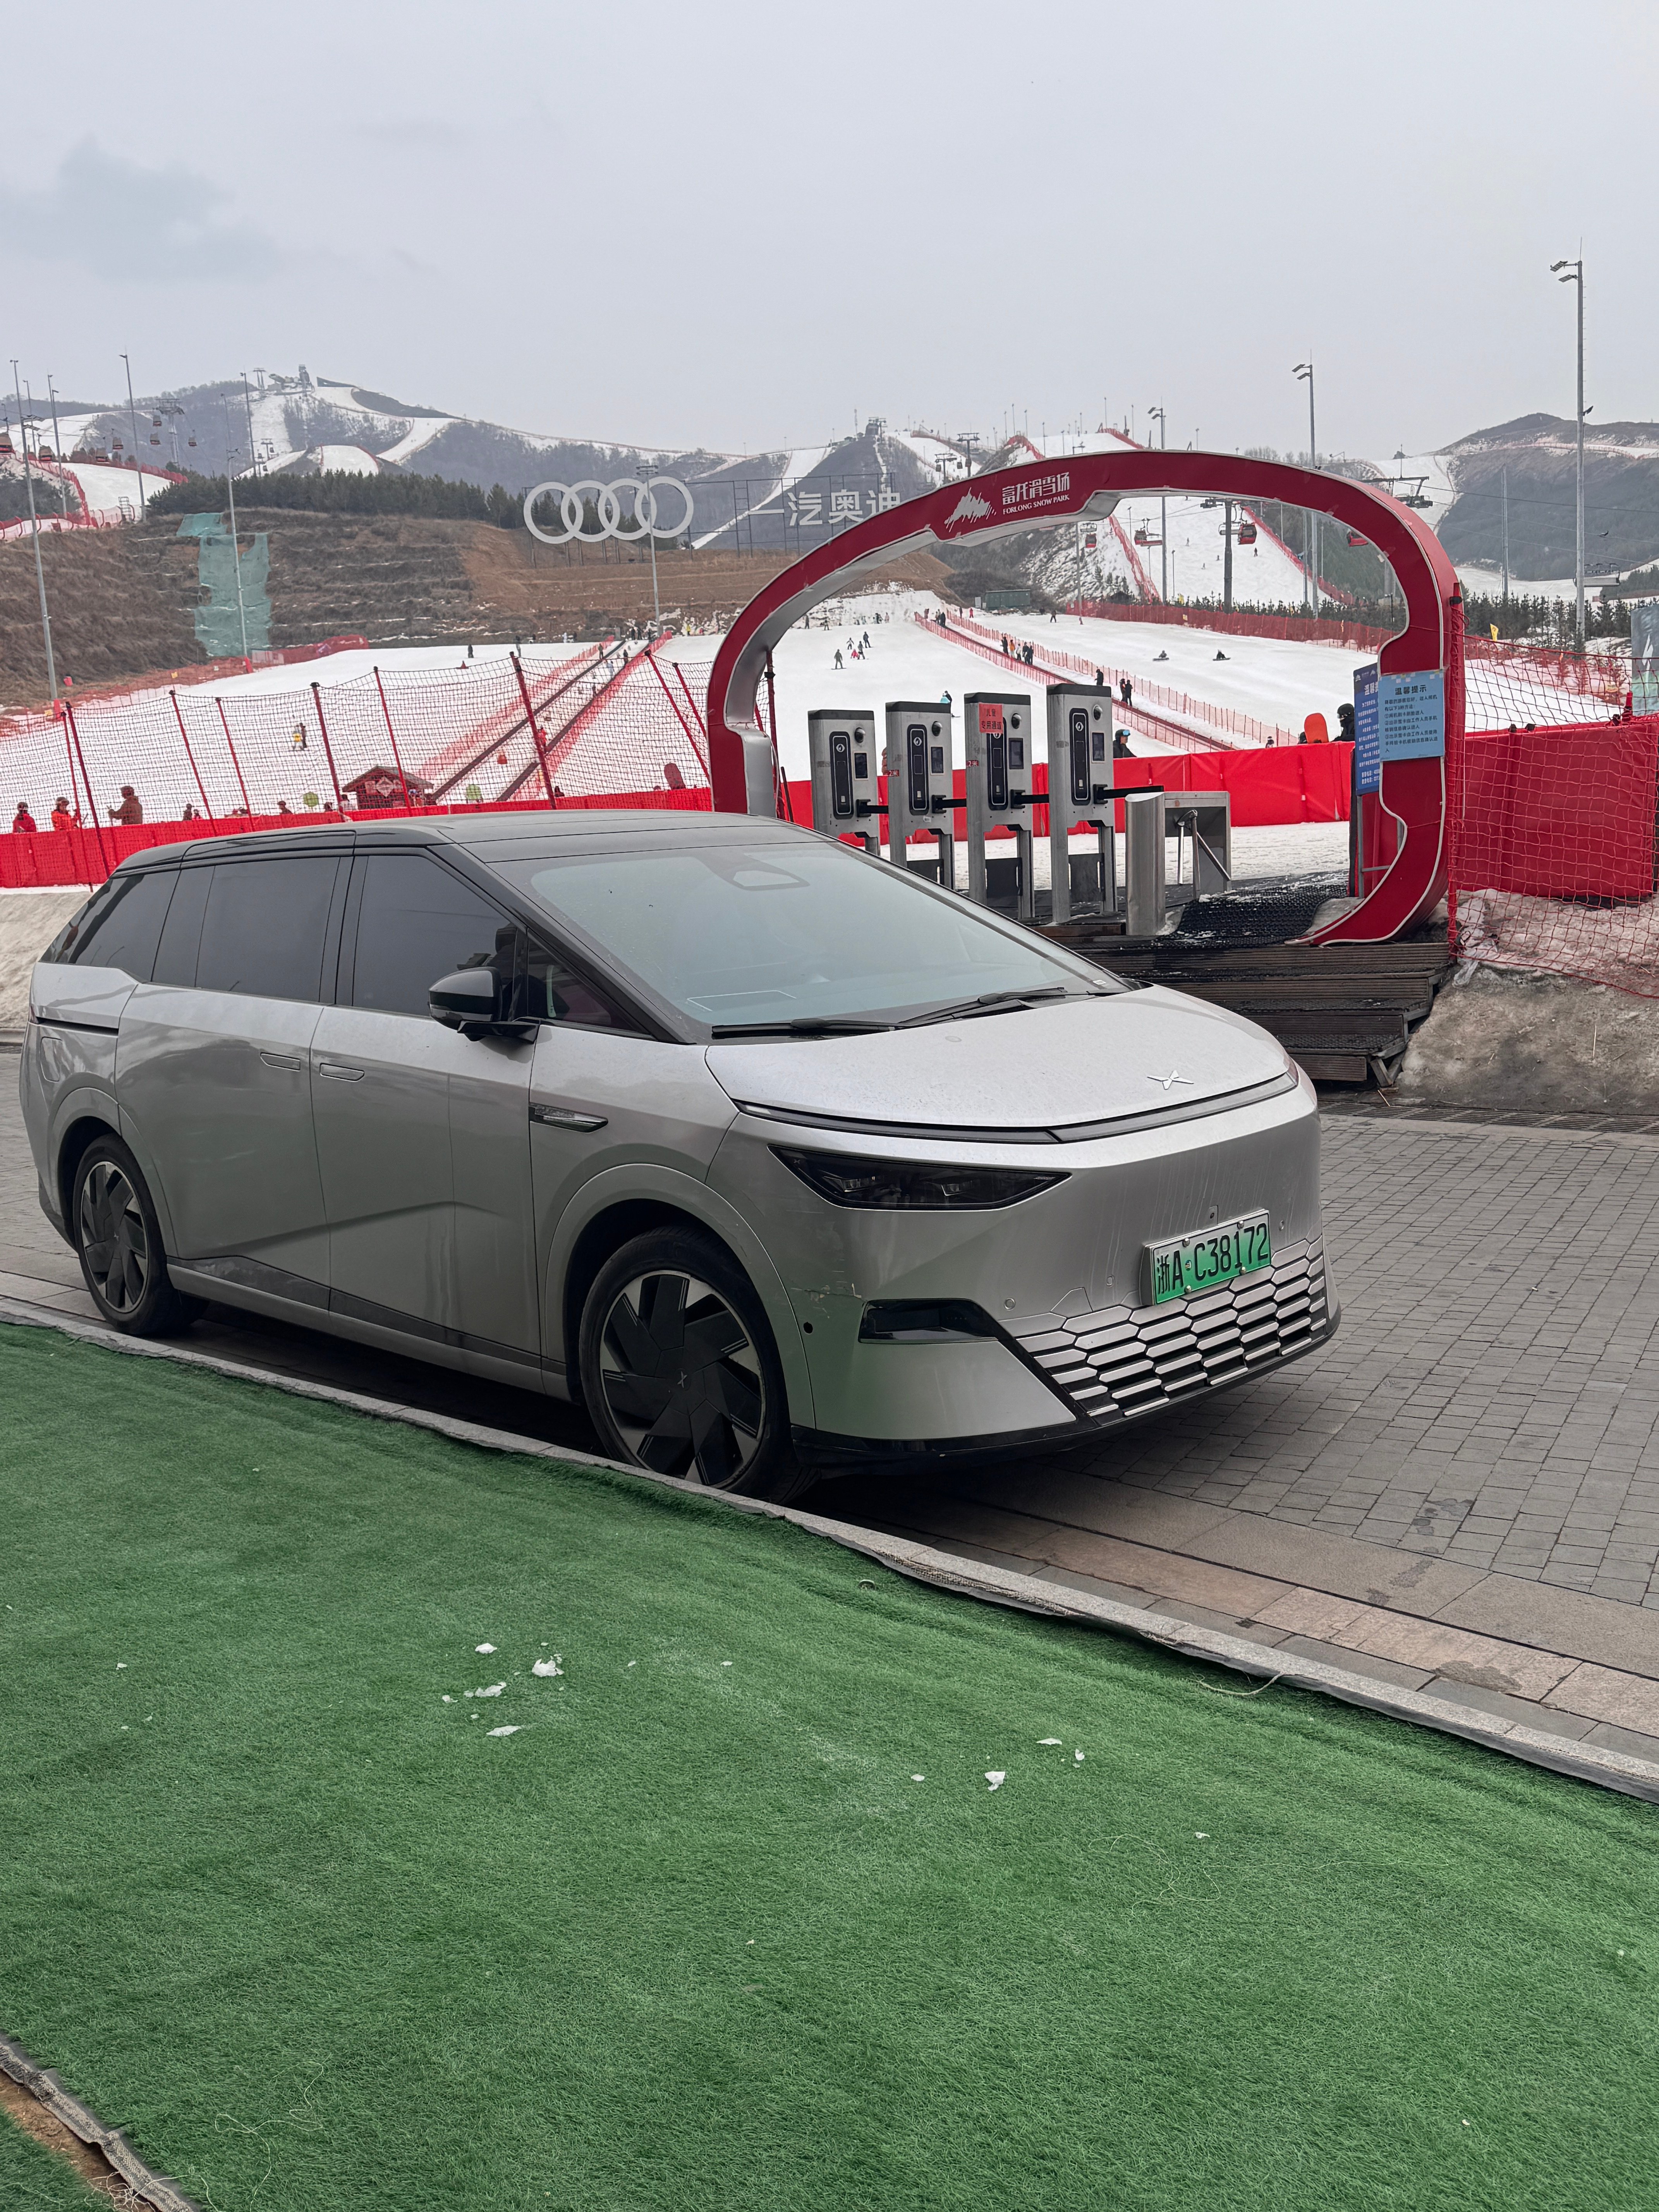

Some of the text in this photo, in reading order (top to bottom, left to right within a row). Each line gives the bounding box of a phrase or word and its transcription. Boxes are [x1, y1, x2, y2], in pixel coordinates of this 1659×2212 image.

[1003, 494, 1070, 515] FORLONG SNOW PARK
[981, 721, 1001, 730] 专用通道
